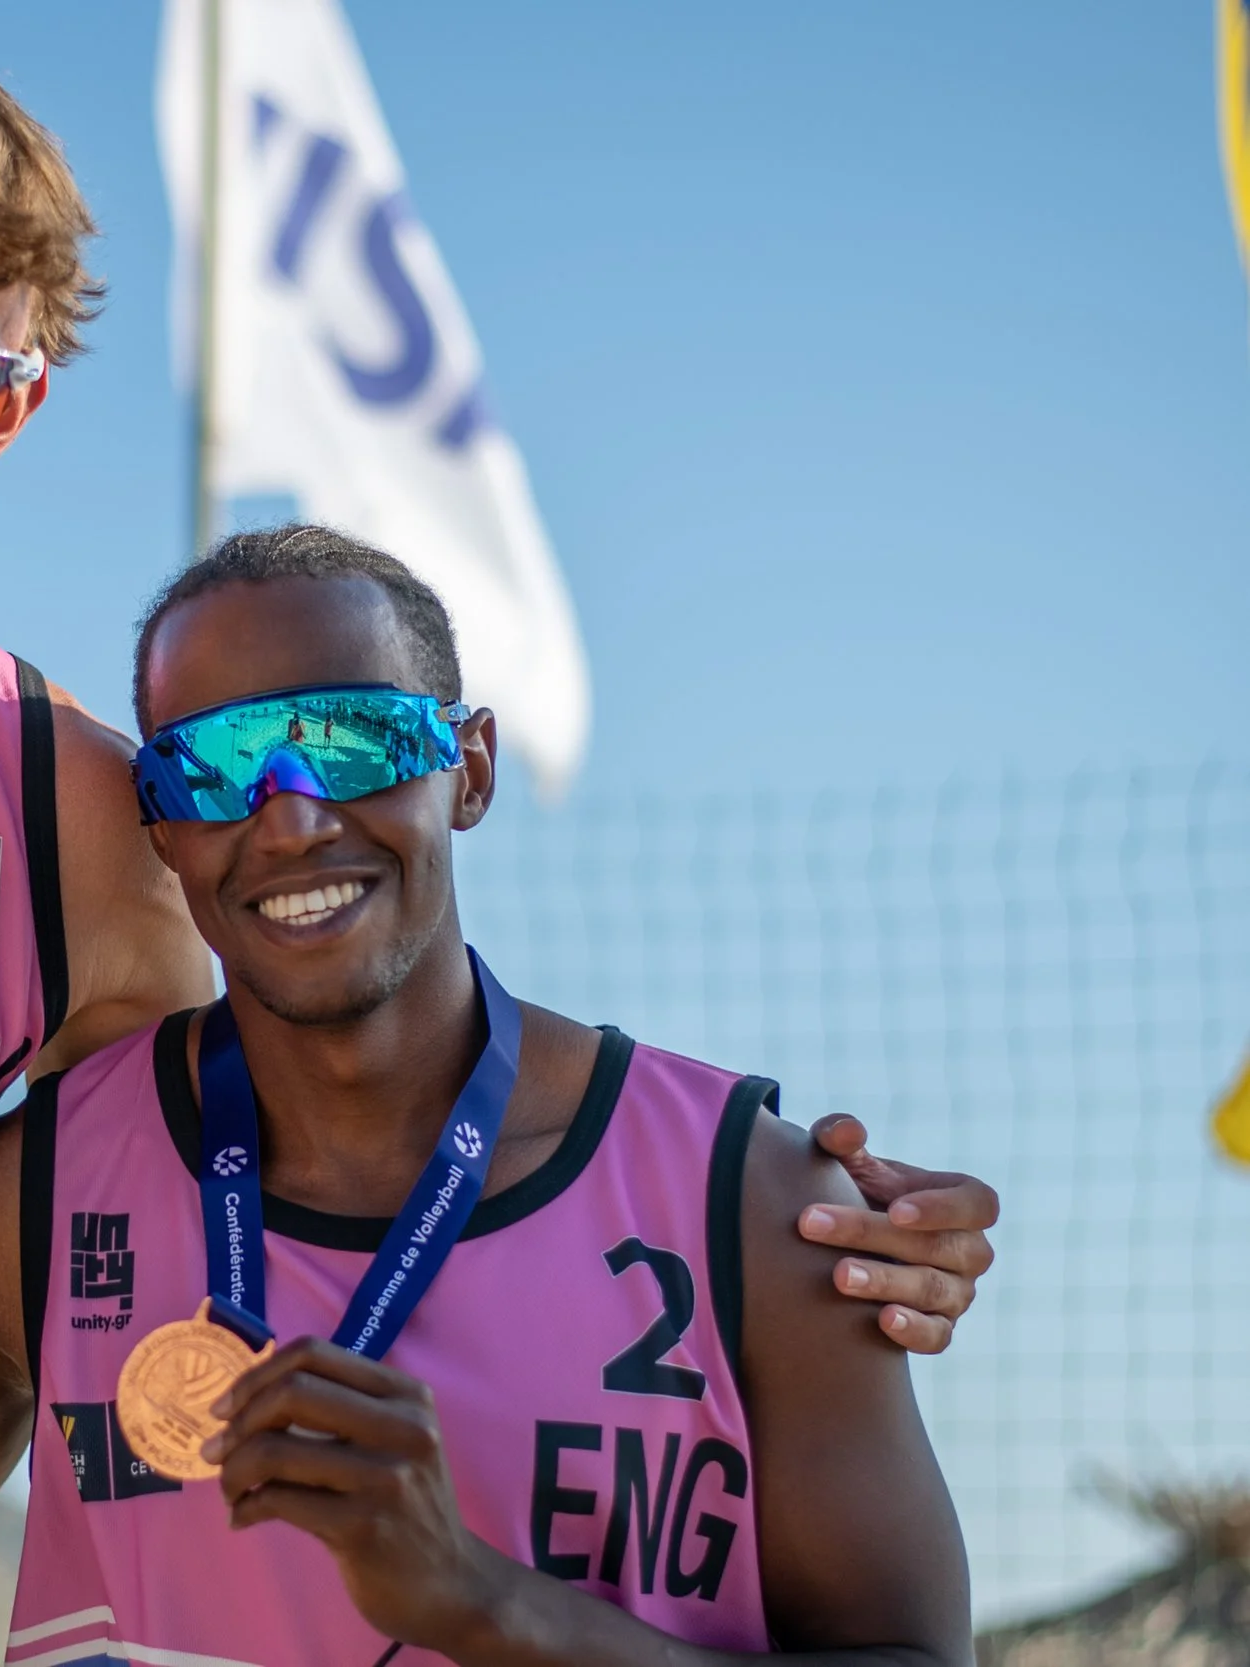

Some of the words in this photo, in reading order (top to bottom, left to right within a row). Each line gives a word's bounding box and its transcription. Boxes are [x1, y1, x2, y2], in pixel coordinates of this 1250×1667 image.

[400, 1246, 420, 1269] de
[410, 1164, 465, 1245] Volleyball
[71, 1313, 133, 1333] unity.gr
[601, 1234, 707, 1402] 2
[530, 1418, 748, 1602] ENG
